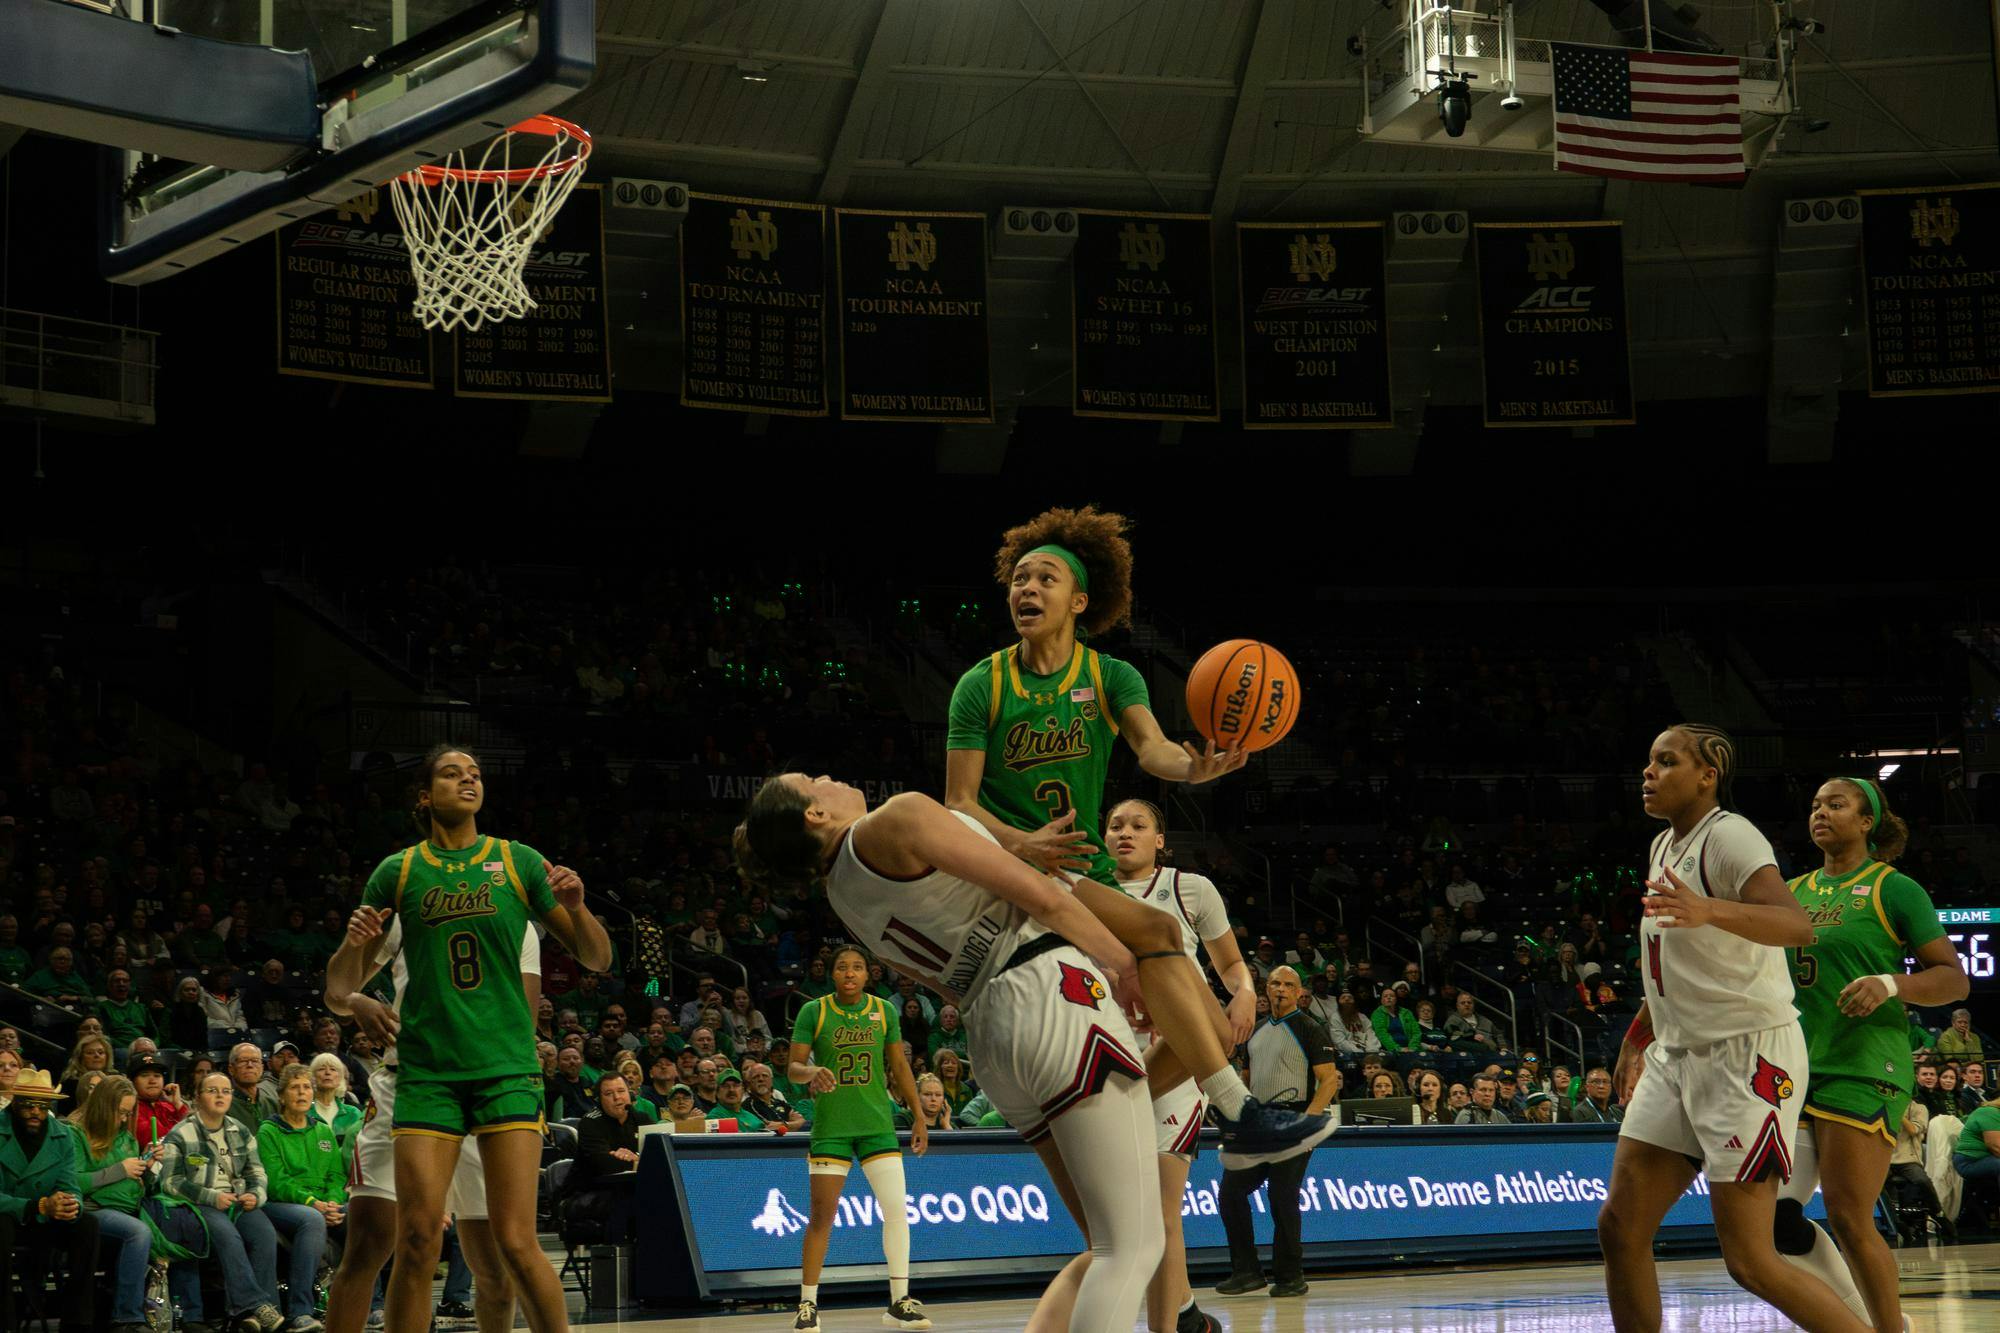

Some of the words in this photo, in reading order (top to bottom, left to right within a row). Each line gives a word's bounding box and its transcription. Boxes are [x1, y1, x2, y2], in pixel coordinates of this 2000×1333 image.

[288, 255, 360, 280] REGULAR
[1909, 255, 1968, 269] NCAA
[726, 265, 782, 285] NCAA
[1871, 272, 1997, 290] TOURNAMEN
[312, 277, 398, 303] CHAMPION
[530, 286, 598, 302] AMENT
[689, 282, 821, 308] TOURNAMENT
[886, 279, 943, 294] NCAA
[1115, 278, 1171, 294] NCAA
[847, 298, 982, 316] TOURNAMENT
[1095, 295, 1165, 315] SWEET
[1171, 301, 1193, 316] 16
[1517, 286, 1596, 308] ACC
[289, 298, 316, 311] 1995
[396, 311, 416, 322] 199
[288, 312, 317, 326] 2000
[323, 317, 350, 331] 2001
[1252, 320, 1298, 335] WEST
[1303, 320, 1377, 335] DIVISION
[1505, 317, 1614, 333] CHAMPIONS
[323, 332, 352, 346] 2005
[360, 336, 387, 350] 2009
[465, 337, 493, 350] 2000
[500, 339, 527, 352] 2001
[536, 340, 564, 352] 2002
[1274, 337, 1358, 352] CHAMPION
[288, 344, 345, 367] WOMEN'S
[349, 352, 425, 375] VOLLEYBALL
[1295, 359, 1337, 376] 2001
[1533, 359, 1580, 376] 2015
[465, 369, 522, 387] WOMEN'S
[526, 372, 603, 389] VOLLEYBALL
[1885, 368, 1925, 384] MEN'S
[689, 378, 744, 398] WOMEN'S
[748, 384, 820, 404] VOLLEYBALL
[1081, 389, 1136, 406] WOMEN'S
[1139, 391, 1212, 410] VOLLEYBALL
[851, 393, 907, 410] WOMEN'S
[910, 395, 986, 411] VOLLEYBALL
[1259, 402, 1298, 417] MEN'S
[1301, 401, 1377, 417] BASKETBALL
[1499, 400, 1537, 416] MEN'S
[1542, 400, 1617, 416] BASKETBALL
[1219, 662, 1257, 734] Wilson
[1259, 679, 1285, 734] NCAA
[1003, 716, 1090, 767] Irish
[853, 780, 904, 802] EAH
[420, 880, 497, 923] Irish
[1803, 902, 1845, 927] ish
[1951, 911, 1991, 922] DAME
[881, 916, 952, 973] 11
[448, 931, 483, 990] 8
[1795, 936, 1818, 988] 5
[832, 1024, 877, 1047] Irish
[837, 1051, 872, 1087] 23
[1298, 1177, 1321, 1212] of
[1323, 1177, 1408, 1210] Notre
[1408, 1175, 1492, 1207] Dame
[1495, 1170, 1609, 1205] Athletics
[834, 1192, 967, 1227] nvsco
[970, 1183, 1050, 1224] QQQ
